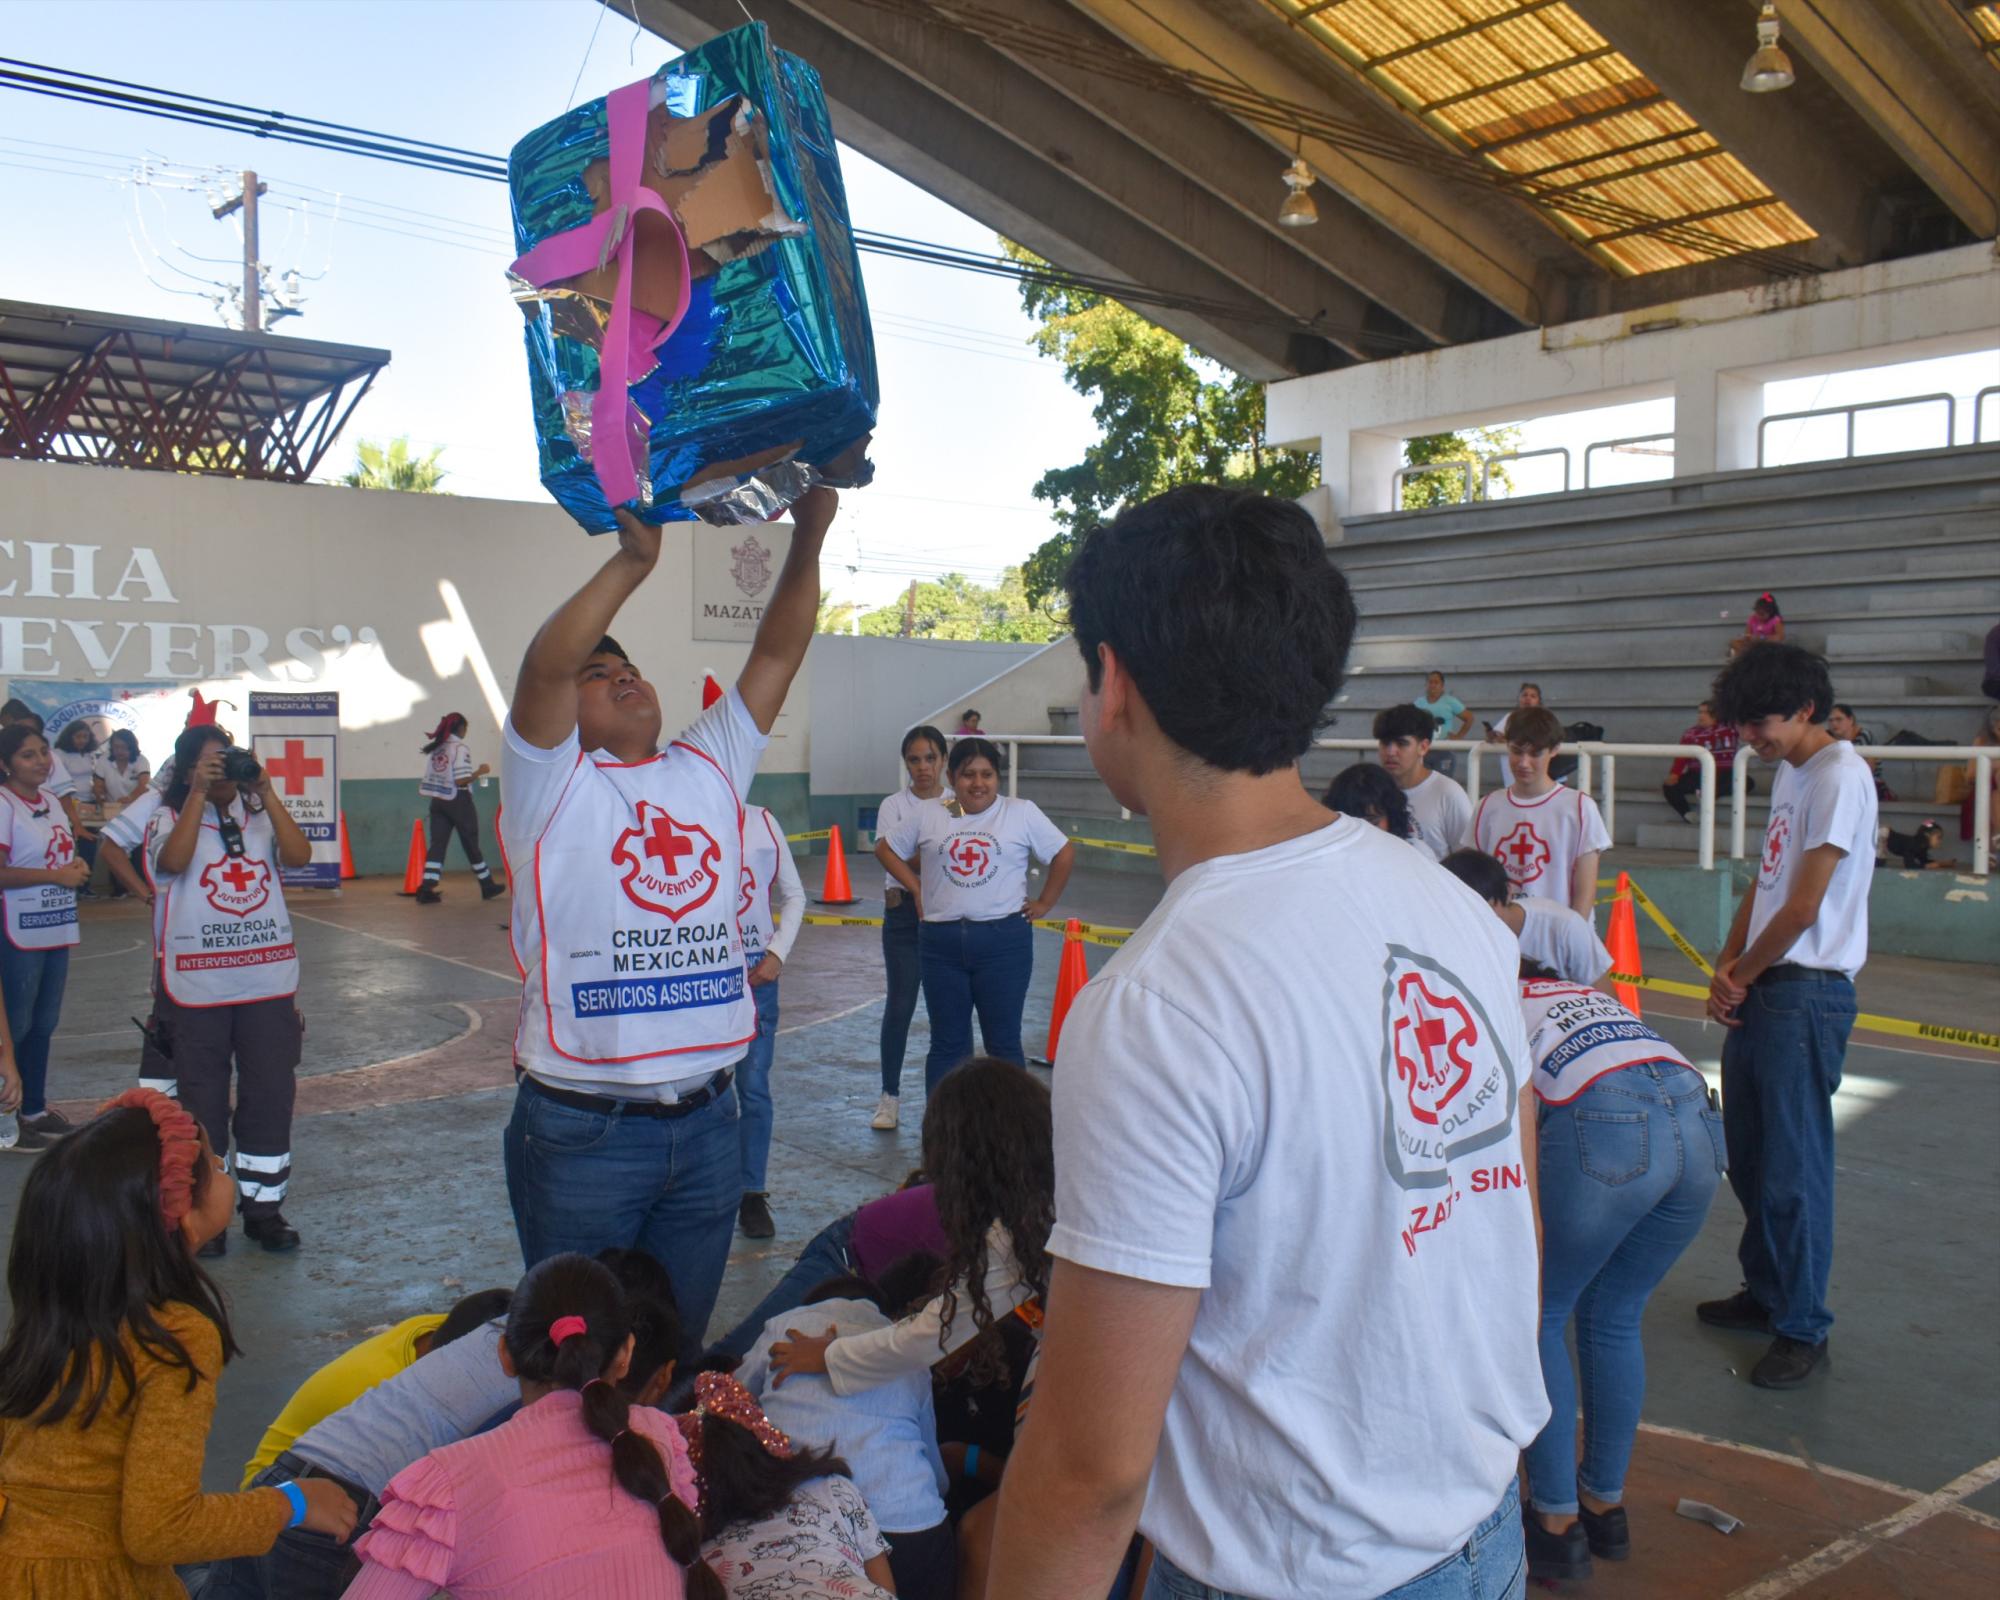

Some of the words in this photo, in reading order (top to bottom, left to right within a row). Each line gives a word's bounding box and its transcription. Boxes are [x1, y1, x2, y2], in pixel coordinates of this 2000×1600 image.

[0, 540, 179, 603] HA
[258, 702, 269, 710] DE
[295, 799, 325, 808] ROJA
[217, 887, 262, 904] JUVENTUD
[638, 869, 705, 897] JUVENTUD
[201, 922, 242, 936] CRUZ
[243, 917, 277, 932] ROJA
[202, 930, 279, 948] MEXICANA
[612, 927, 672, 950] CRUZ
[677, 921, 729, 945] ROJA
[265, 946, 296, 961] SOCIAL
[613, 944, 729, 973] MEXICANA
[578, 984, 658, 1012] SERVICIOS
[660, 973, 743, 1006] ASISTENCIALES
[1546, 996, 1596, 1019] CRUZ
[1547, 1024, 1616, 1074] SERVICIOS
[1470, 1163, 1528, 1193] SIN.
